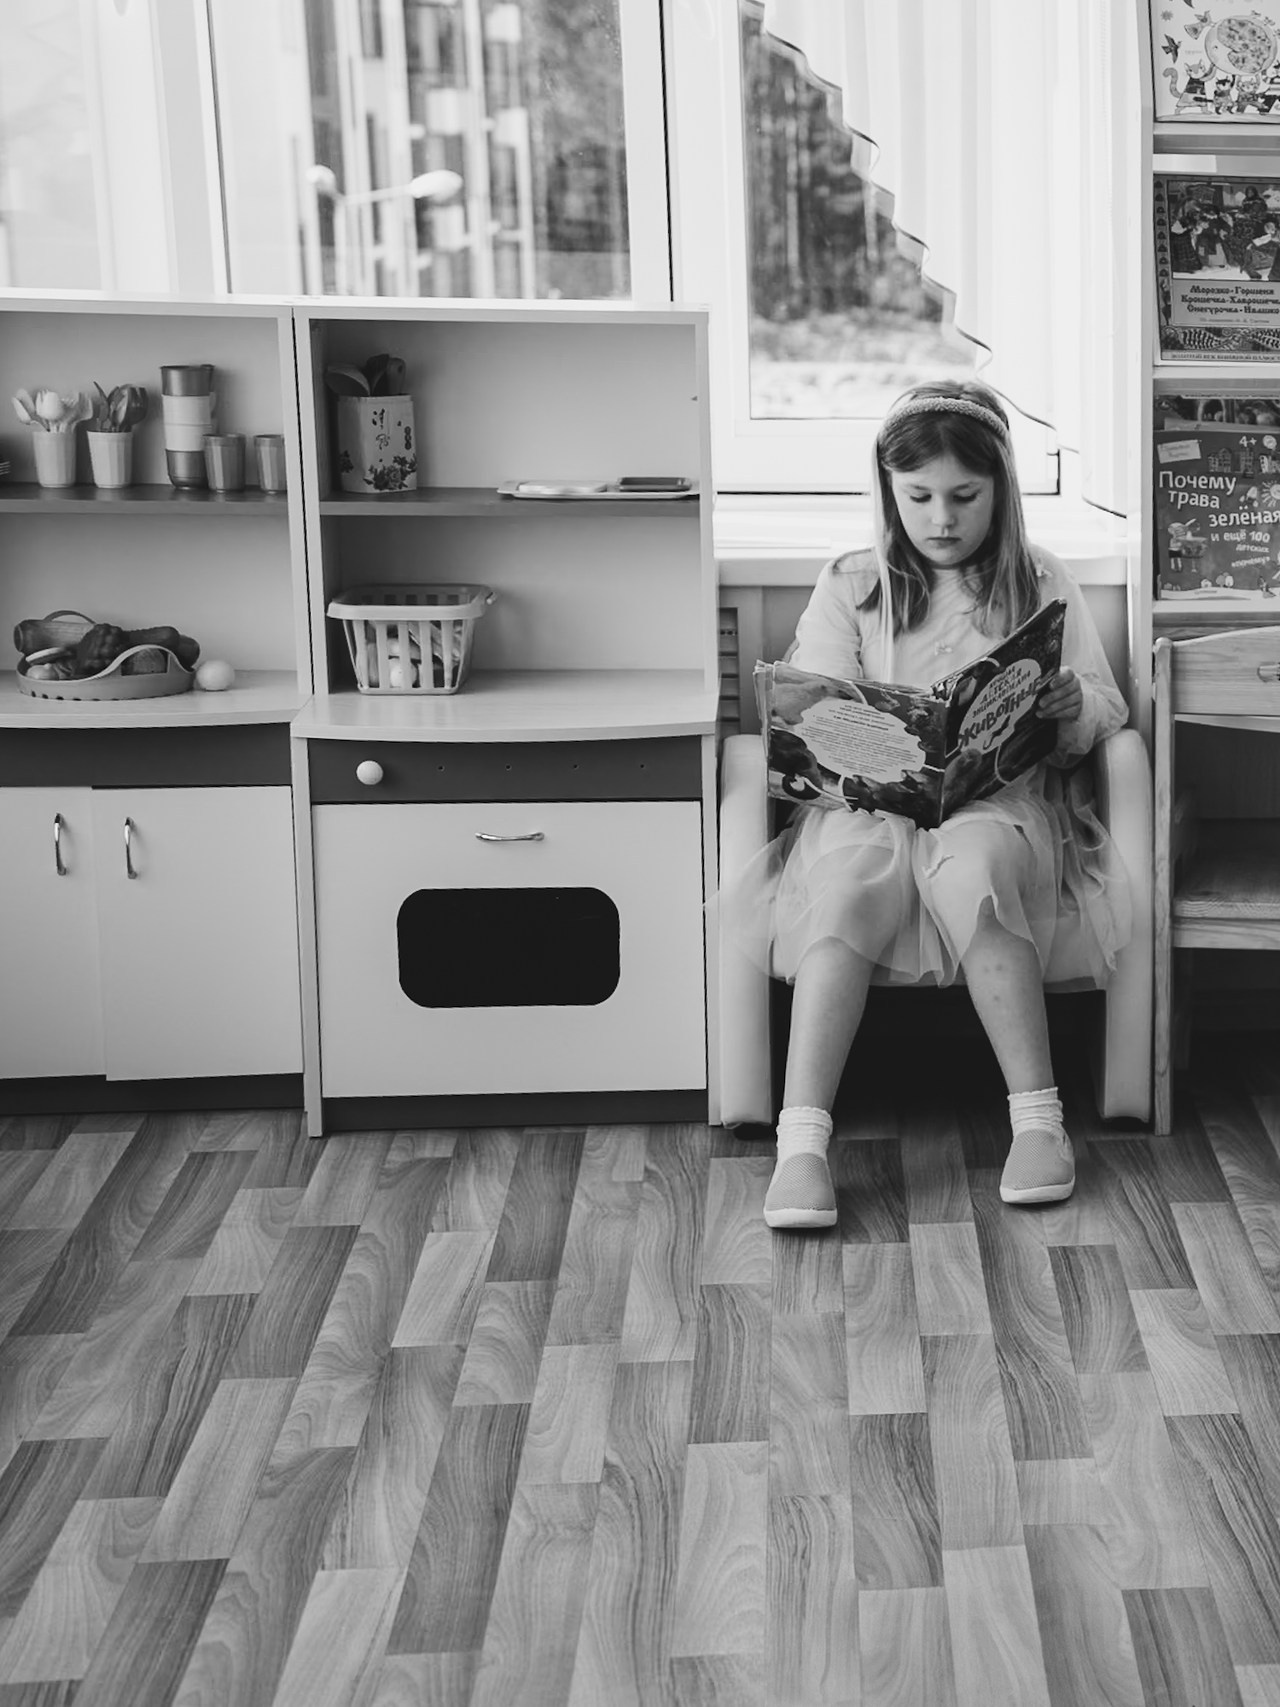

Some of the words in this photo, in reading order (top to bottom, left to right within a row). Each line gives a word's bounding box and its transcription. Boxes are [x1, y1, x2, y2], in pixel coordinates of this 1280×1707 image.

[1239, 435, 1257, 448] 4+
[1159, 471, 1237, 496] Почему
[1168, 490, 1220, 510] трава
[1210, 532, 1220, 542] и
[1223, 529, 1247, 542] ещё
[1249, 530, 1271, 543] 100
[958, 677, 1043, 749] ЖИВОТНЫЕ
